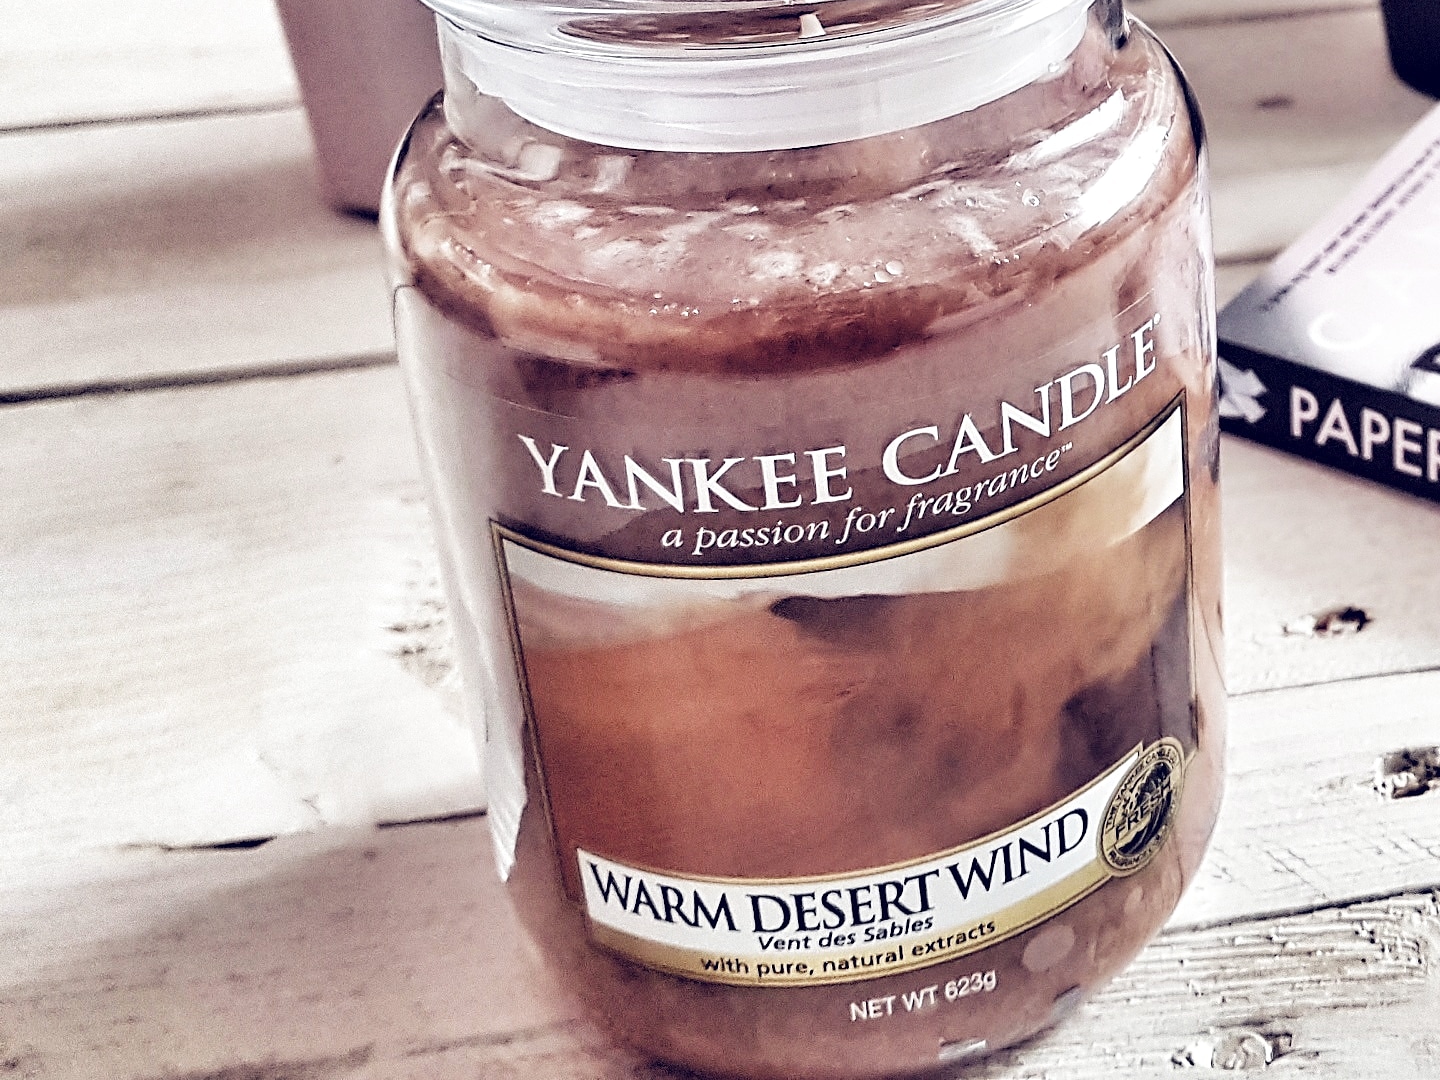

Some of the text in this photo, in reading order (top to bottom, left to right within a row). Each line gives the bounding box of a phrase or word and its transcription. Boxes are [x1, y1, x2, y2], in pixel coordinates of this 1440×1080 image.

[516, 433, 854, 514] YANKEE
[660, 528, 684, 548] a
[691, 519, 830, 556] passion
[835, 506, 896, 545] for
[1115, 775, 1173, 840] FRESH
[588, 861, 740, 933] WARM
[746, 868, 940, 933] DESERT
[946, 807, 1090, 901] WIND
[699, 918, 998, 978] with pure, natural extracts
[758, 915, 935, 951] Vent des Sables
[850, 969, 999, 1023] NET WT 623g
